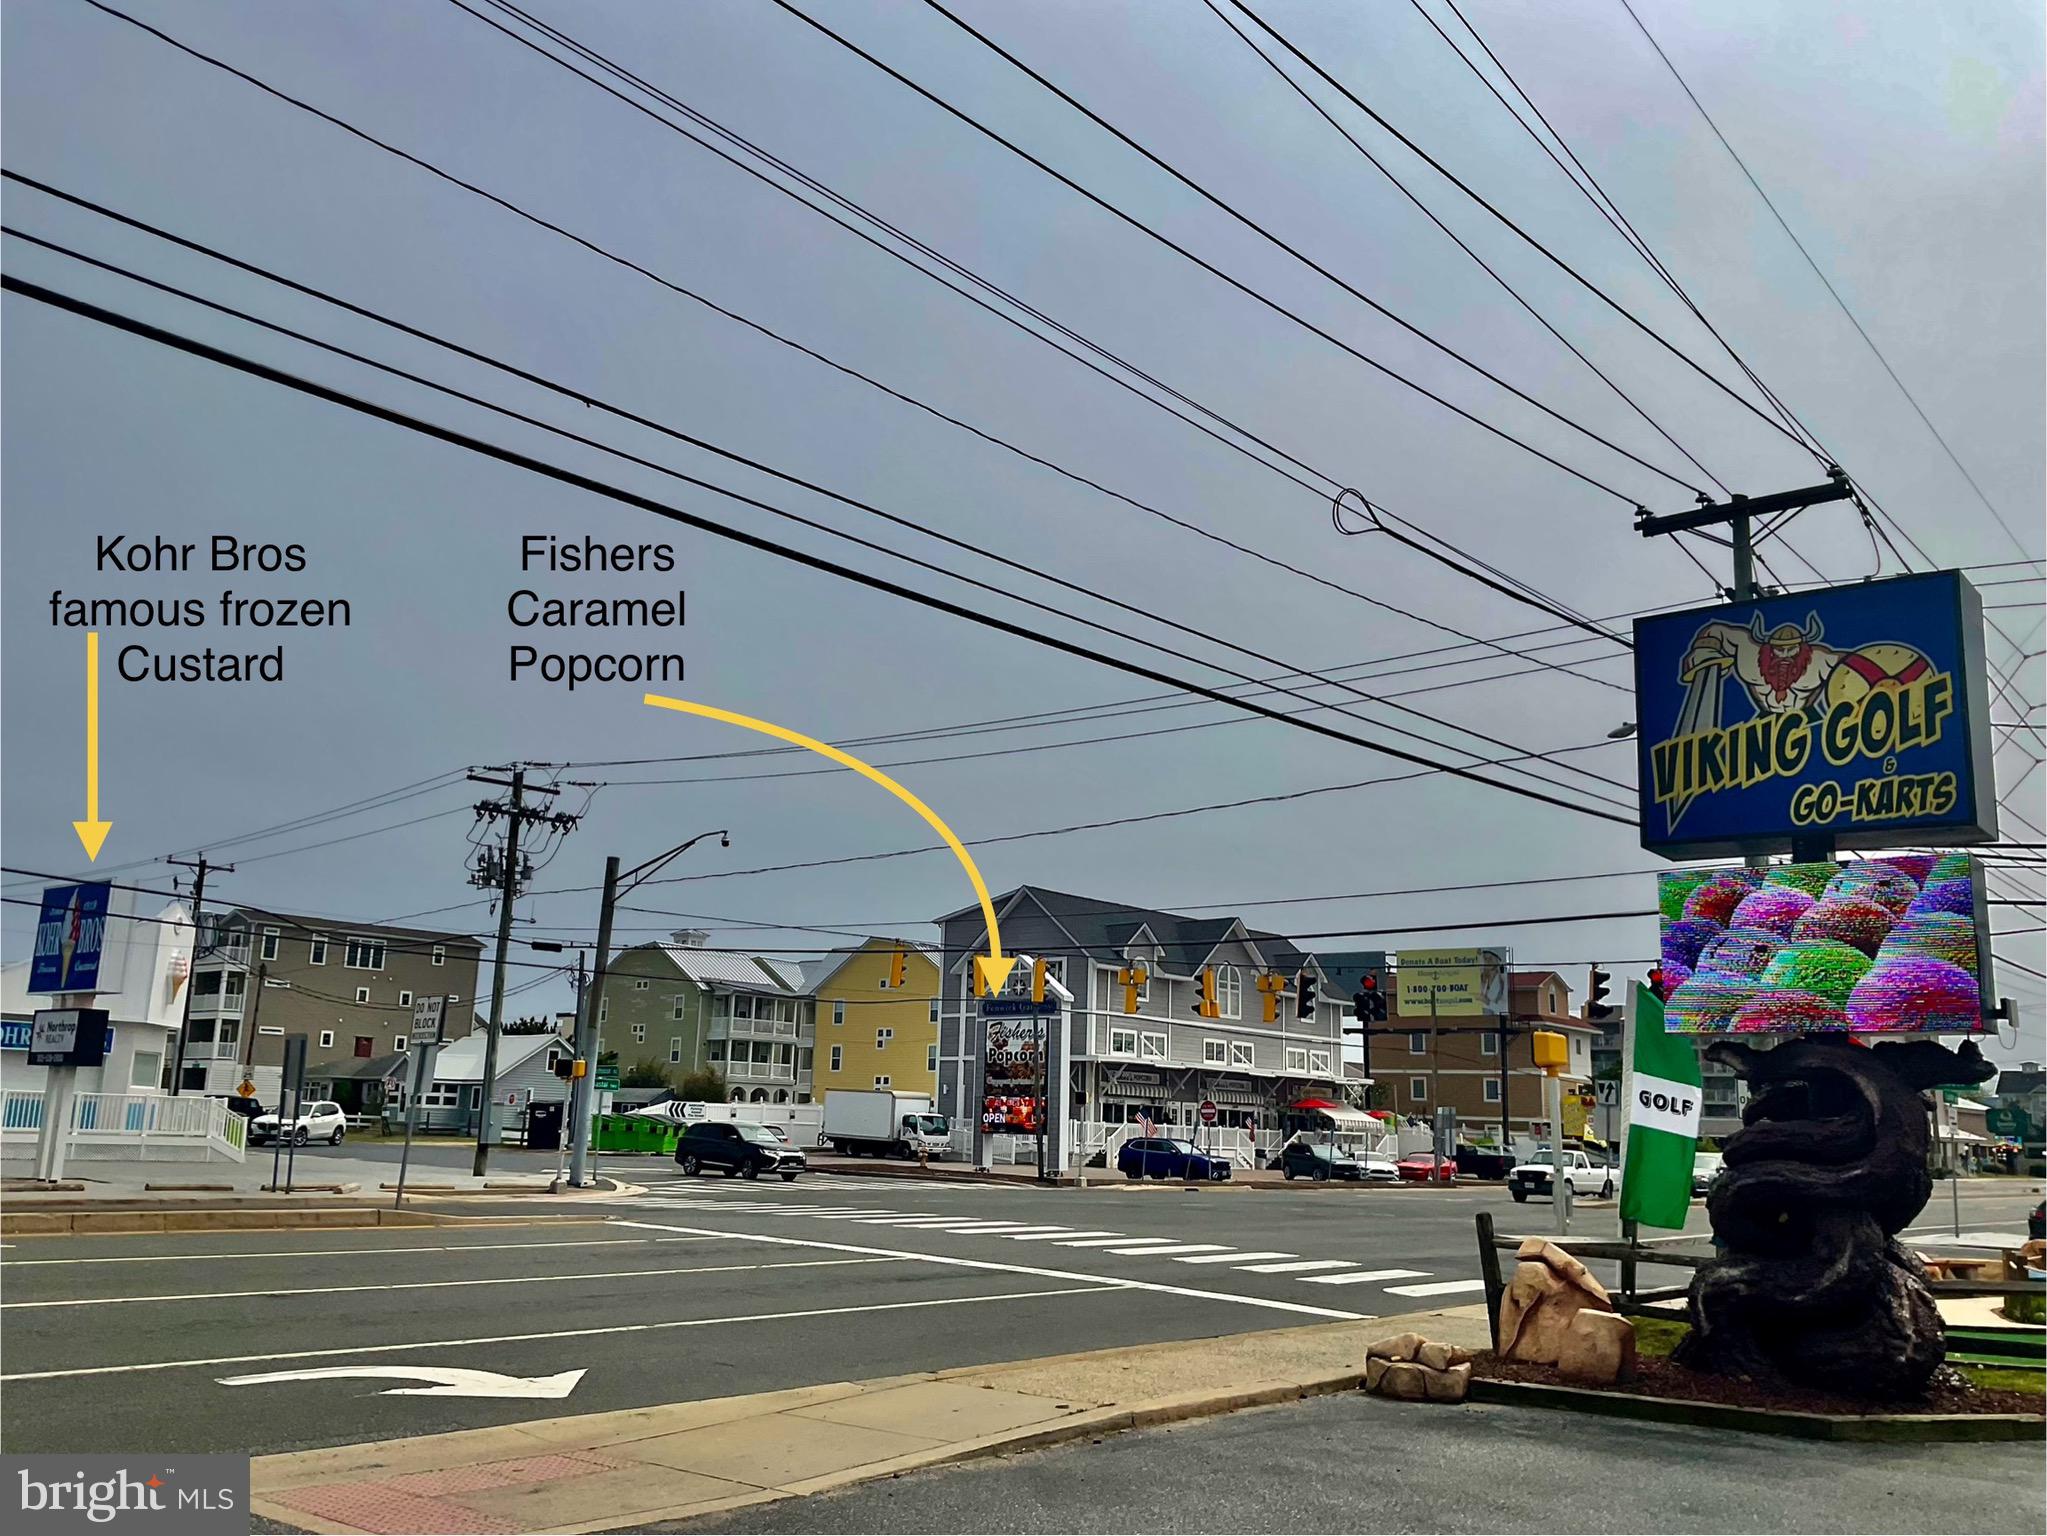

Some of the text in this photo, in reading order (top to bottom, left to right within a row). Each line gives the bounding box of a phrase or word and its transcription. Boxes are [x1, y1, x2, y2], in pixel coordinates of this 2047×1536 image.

[1651, 671, 1953, 803] VIKING GOLF
[1883, 756, 1897, 774] &
[1790, 771, 1957, 826] GO-KARTS
[76, 916, 106, 954] BROS
[416, 1001, 440, 1013] DO NOT
[414, 1017, 436, 1029] BLOCK
[1639, 1090, 1694, 1117] GOLF
[982, 1113, 1006, 1123] OPEN
